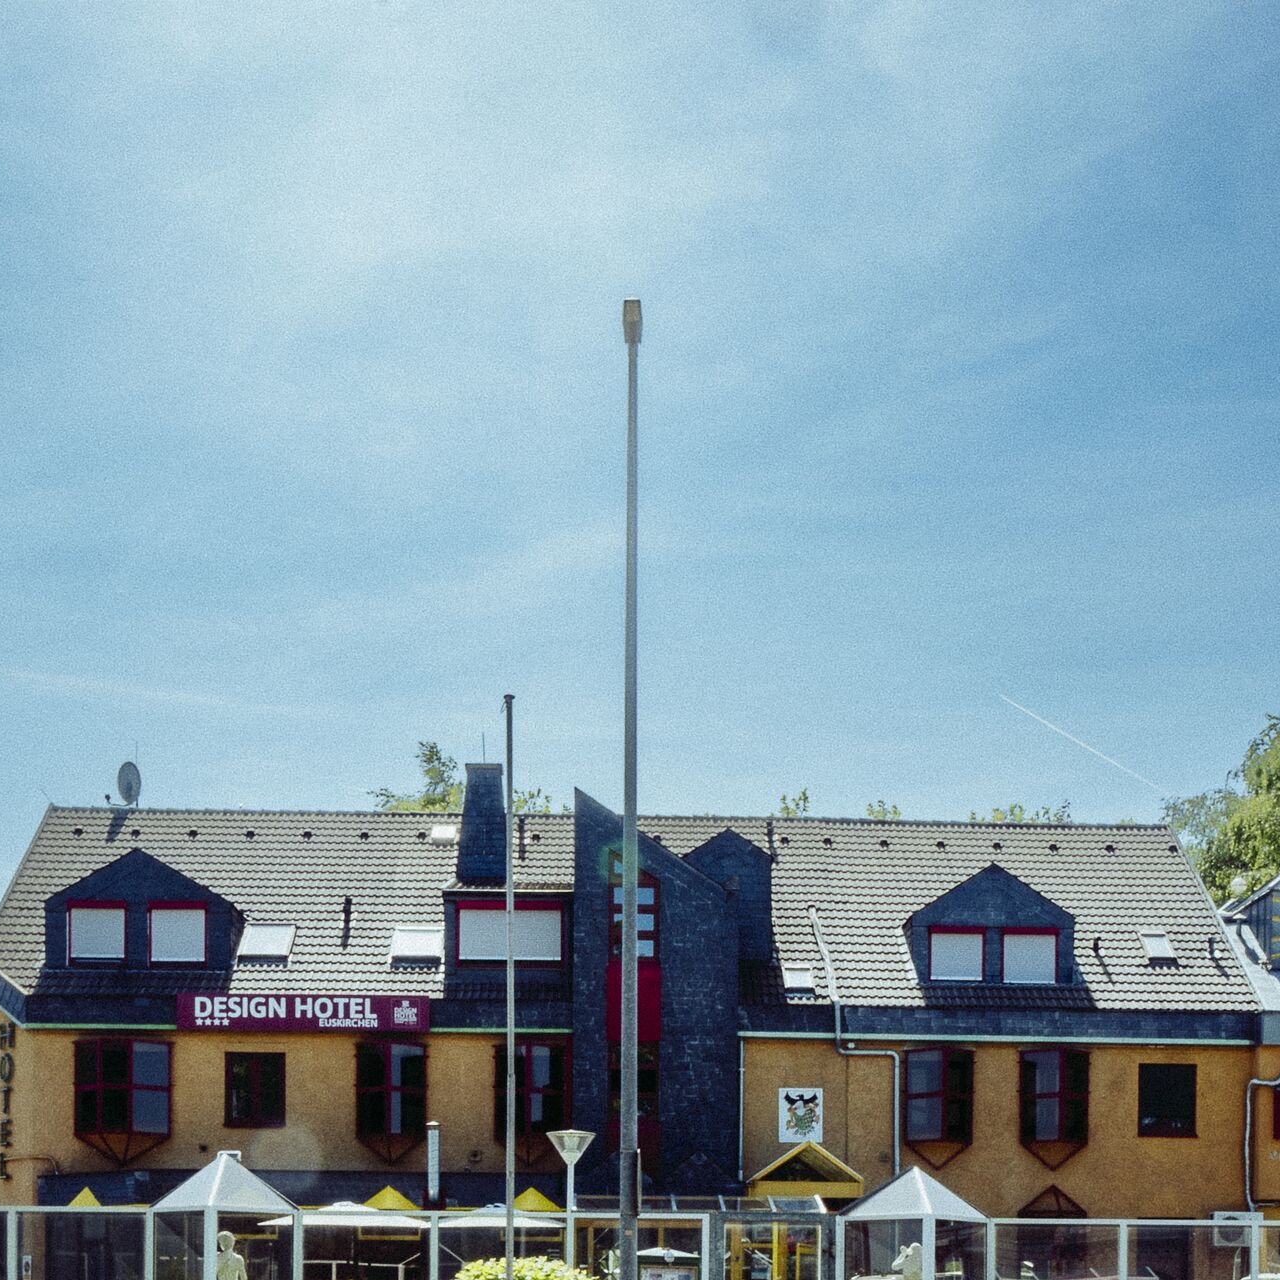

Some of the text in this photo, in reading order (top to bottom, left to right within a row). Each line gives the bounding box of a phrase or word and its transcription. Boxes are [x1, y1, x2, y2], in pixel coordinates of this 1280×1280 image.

[194, 996, 378, 1019] DESIGN HOTEL
[318, 1018, 378, 1028] EUSKIRCHEN
[0, 1021, 16, 1180] HOTEL
